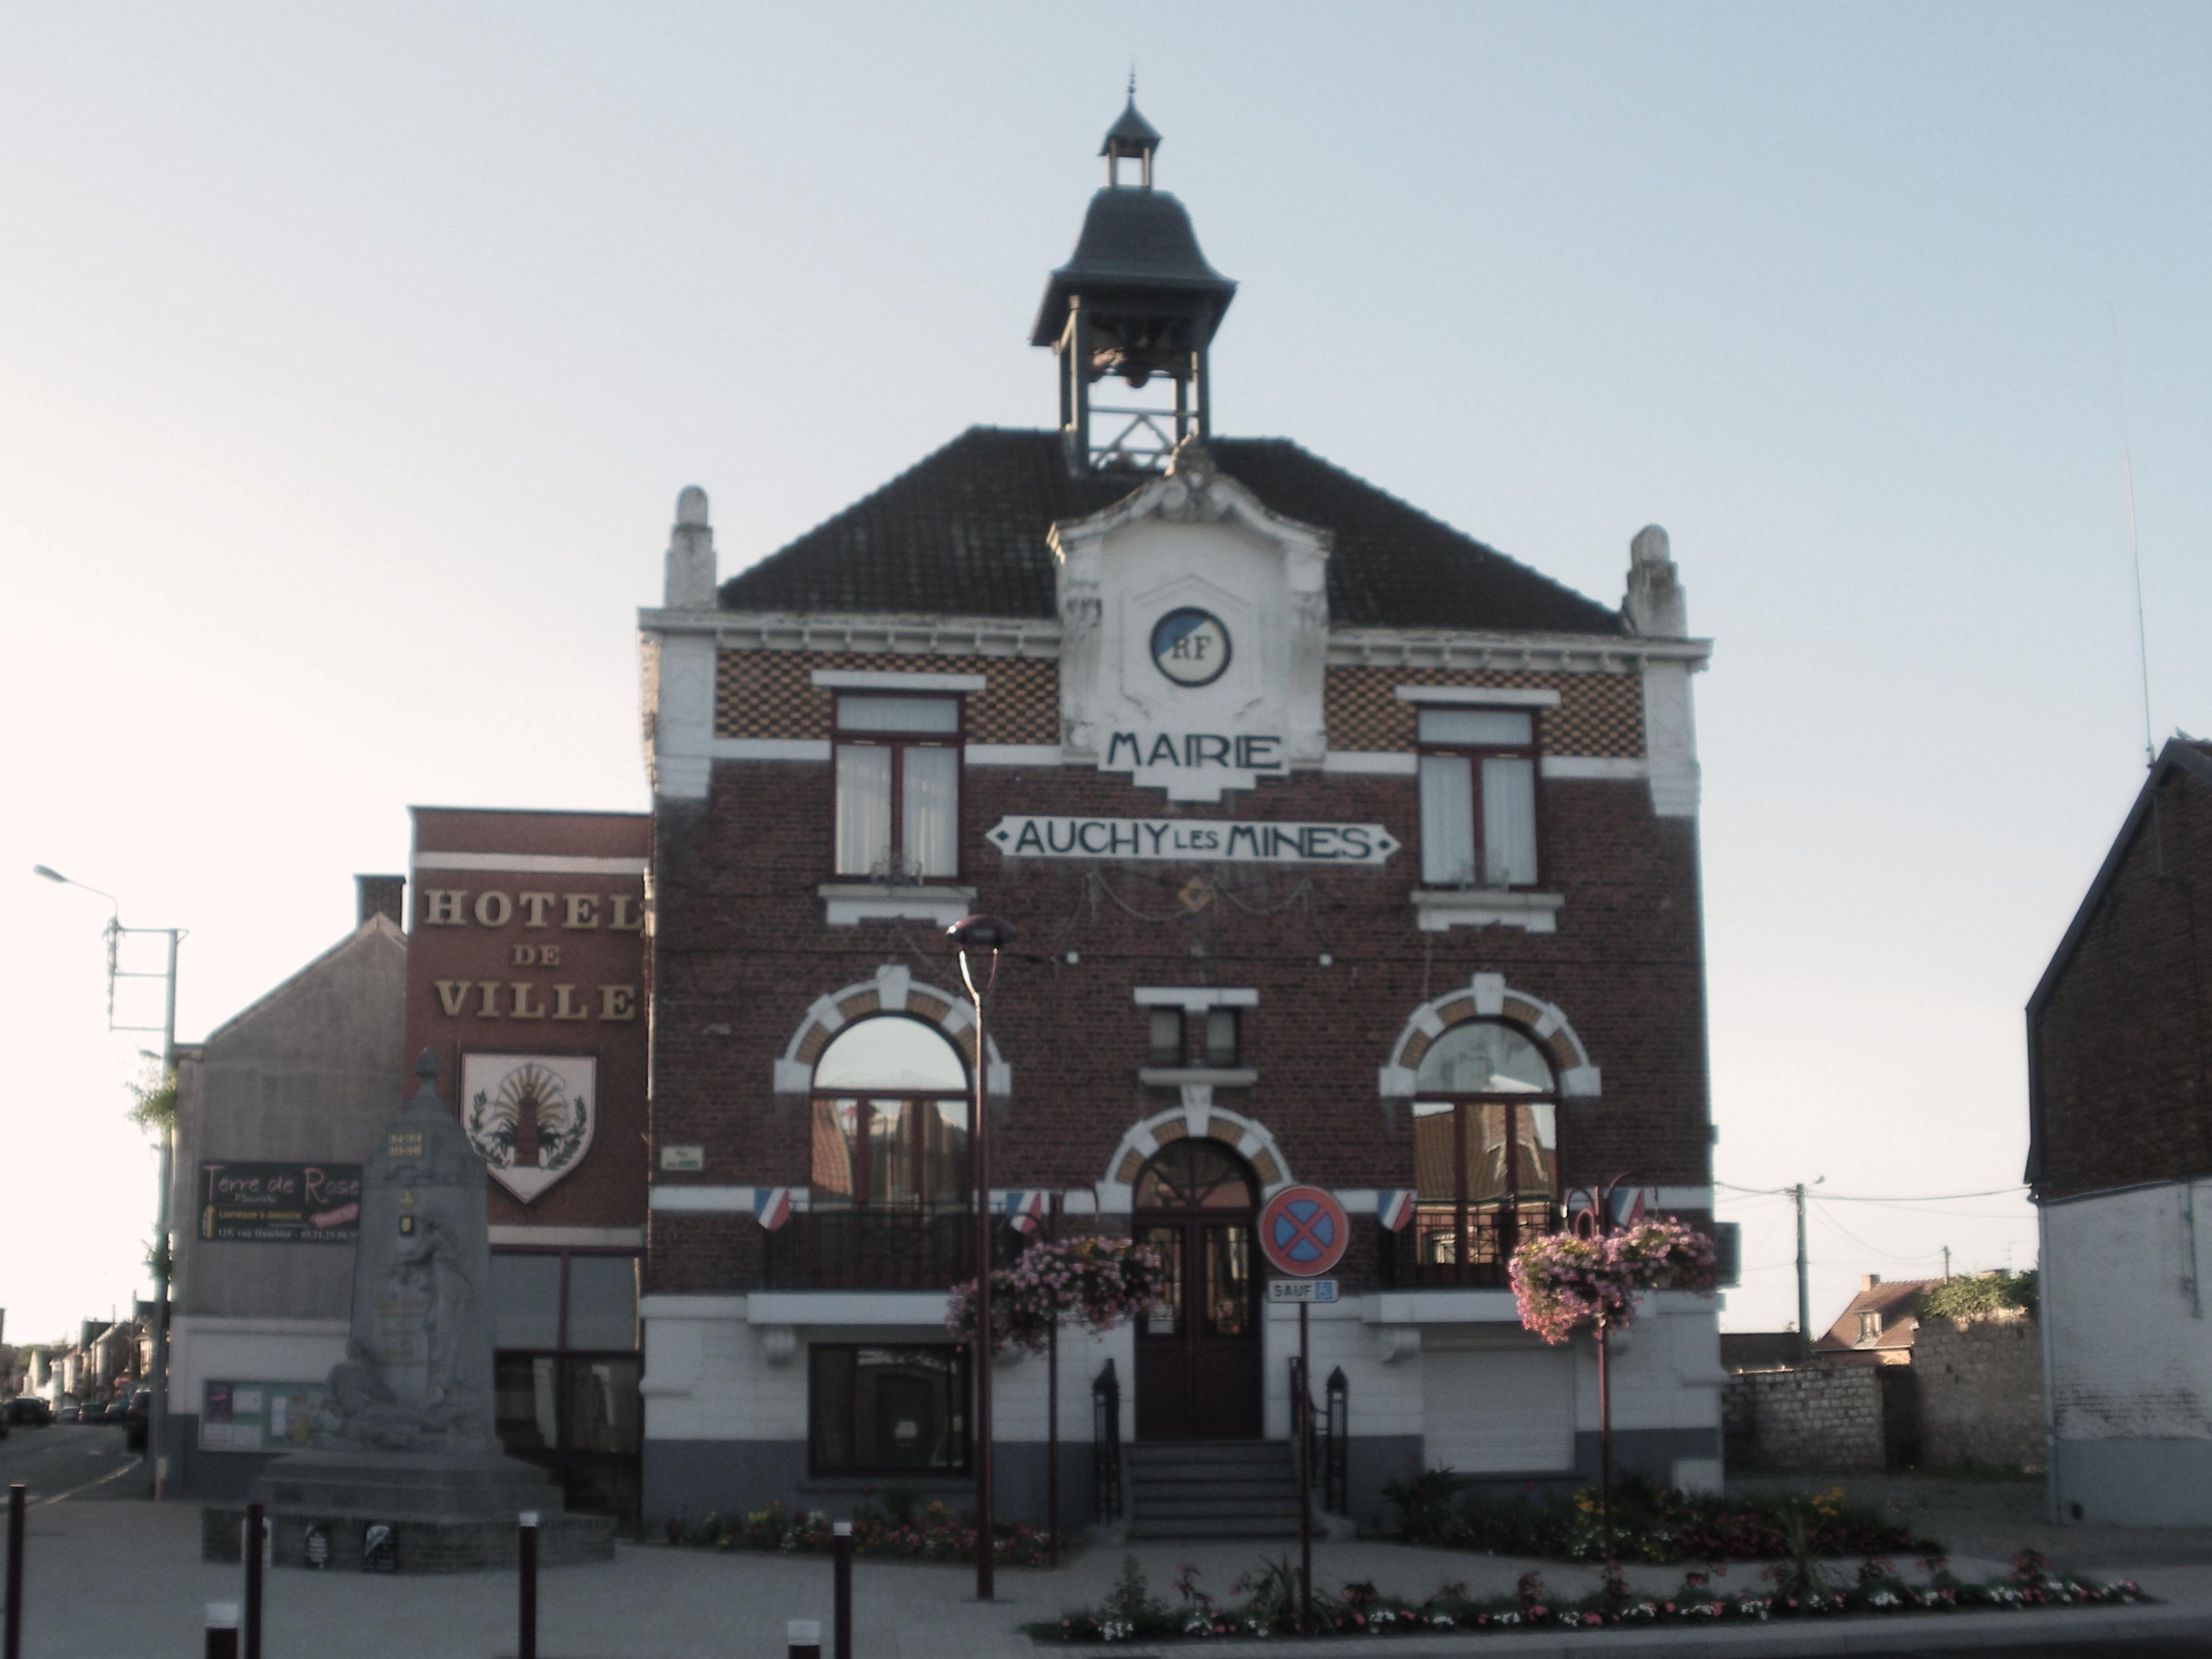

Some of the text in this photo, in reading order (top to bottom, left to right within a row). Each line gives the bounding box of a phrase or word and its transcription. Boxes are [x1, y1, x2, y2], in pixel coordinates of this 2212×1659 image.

[1171, 634, 1212, 661] RF
[1107, 732, 1282, 770] MAIRIE
[1015, 820, 1372, 859] AUCHY LES MINES
[424, 889, 644, 930] HOTEL
[512, 945, 561, 967] DE
[434, 980, 636, 1021] VILLE
[203, 1165, 359, 1205] Terre de Rose
[1273, 1284, 1312, 1297] SAUF
